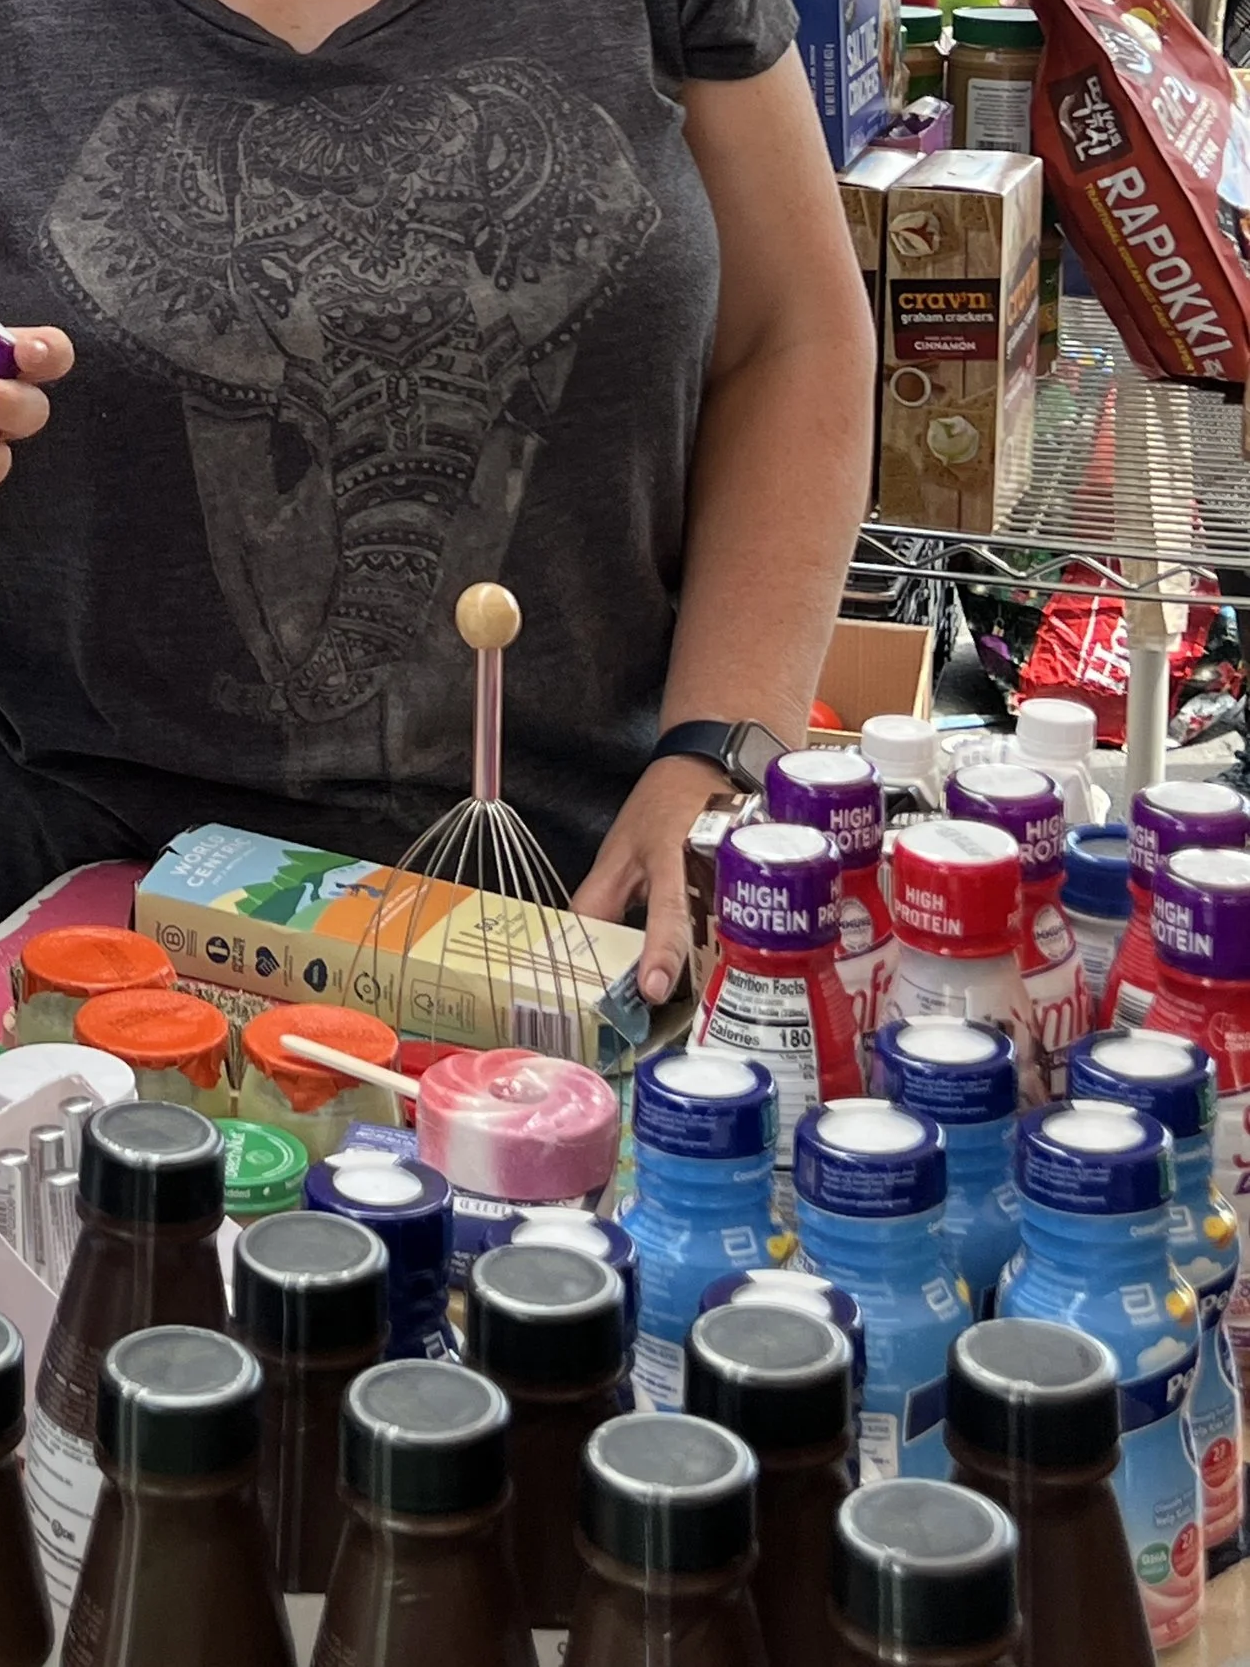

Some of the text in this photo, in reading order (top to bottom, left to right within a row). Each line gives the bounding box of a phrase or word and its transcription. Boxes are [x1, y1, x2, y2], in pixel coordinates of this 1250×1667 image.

[847, 16, 878, 77] SALTINE
[1096, 166, 1234, 357] RAPOKKI
[900, 311, 994, 324] graham crackers
[914, 341, 977, 351] CINNAMON
[830, 805, 874, 830] HIGH
[170, 834, 225, 876] WORLD
[187, 836, 251, 887] CENTRIC
[737, 880, 788, 910] HIGH
[905, 884, 944, 912] HIGH
[722, 896, 810, 933] PROTEIN
[894, 903, 962, 937] PROTEIN
[727, 969, 806, 995] Nutrition Facts
[709, 1019, 812, 1047] Calories 180
